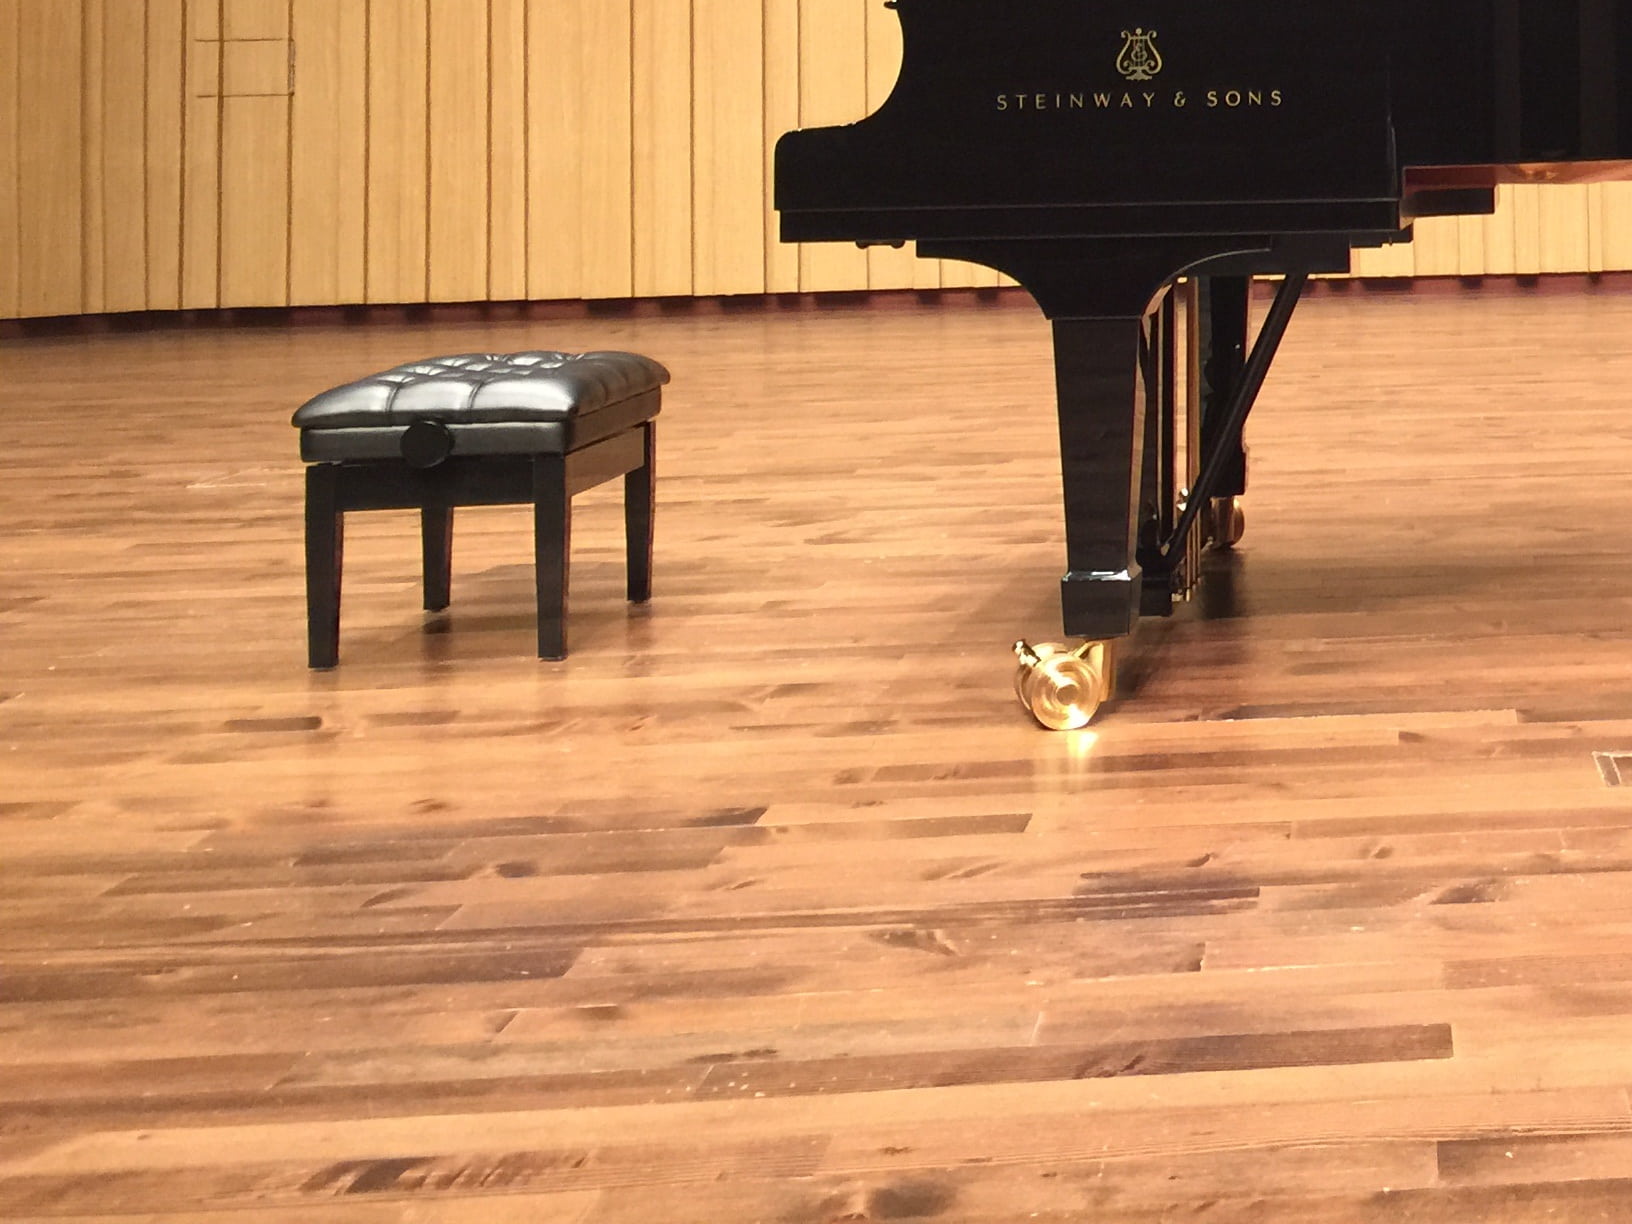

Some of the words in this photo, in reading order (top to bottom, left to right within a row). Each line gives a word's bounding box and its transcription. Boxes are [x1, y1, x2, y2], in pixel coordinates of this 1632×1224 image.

[997, 92, 1156, 111] STEINWAY
[1173, 90, 1187, 108] &
[1206, 89, 1282, 108] SONS
